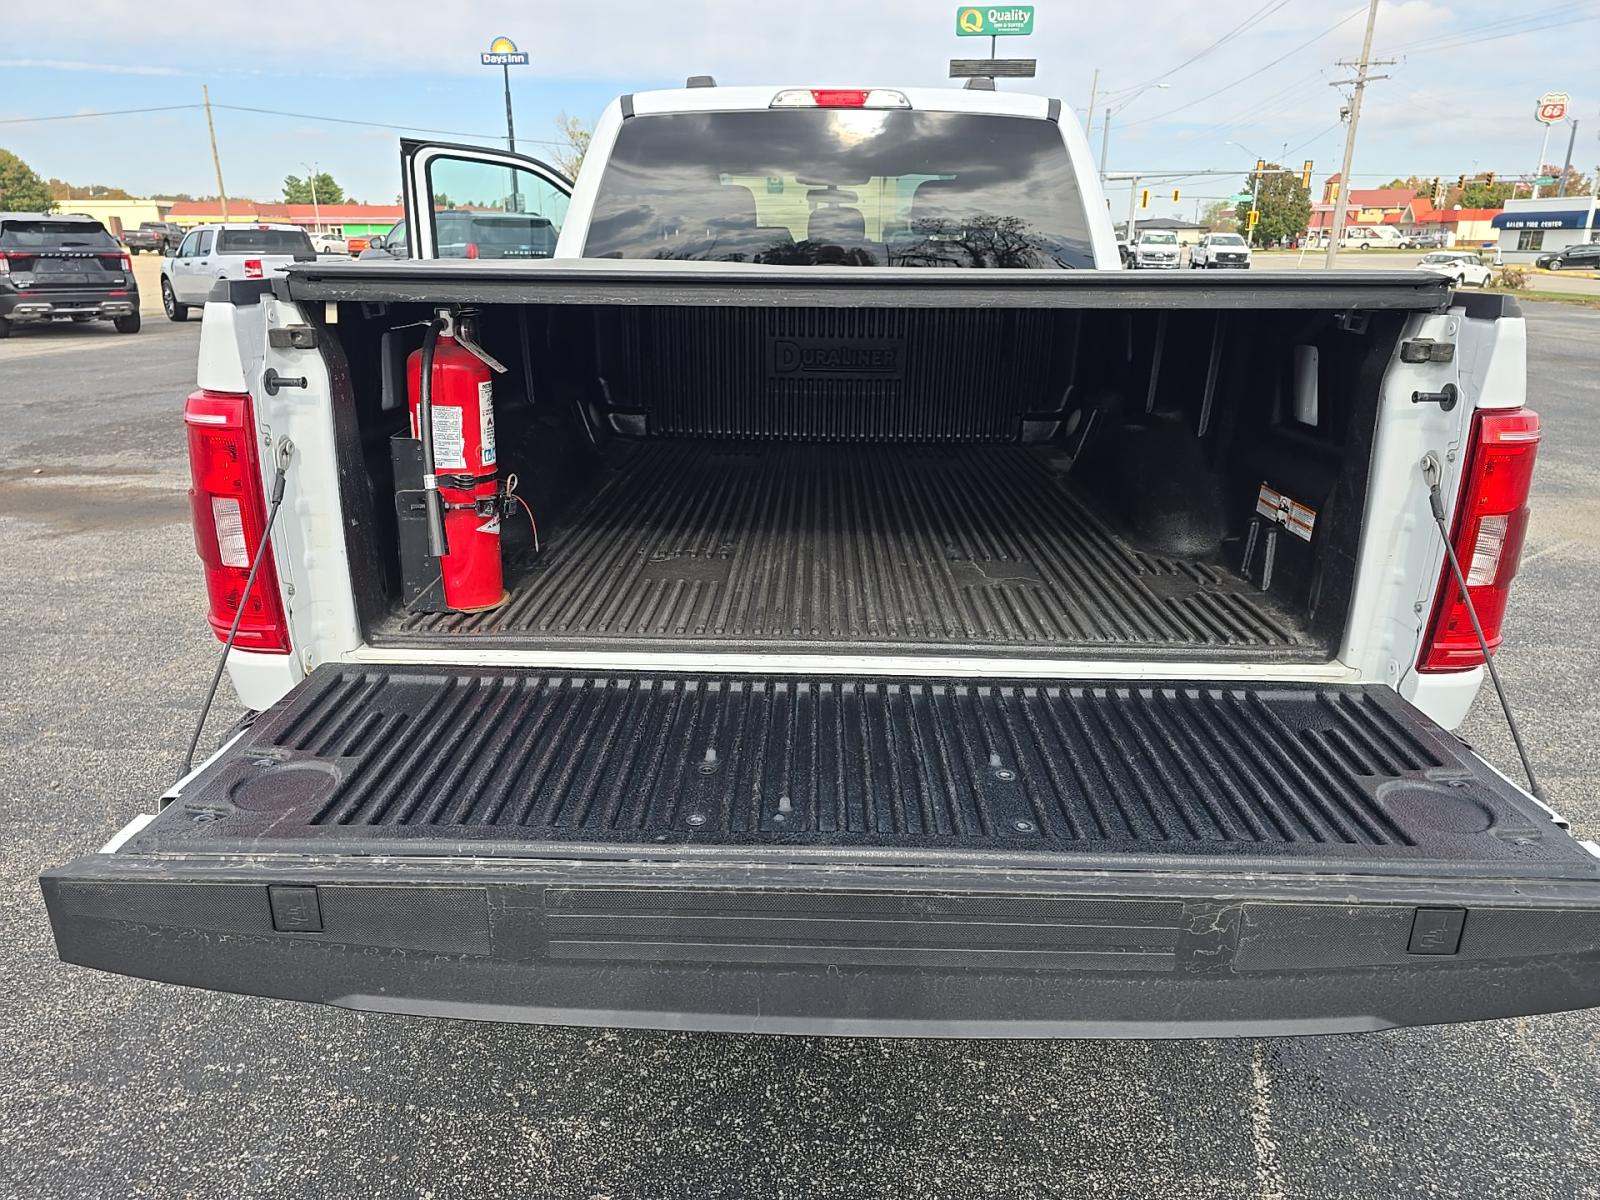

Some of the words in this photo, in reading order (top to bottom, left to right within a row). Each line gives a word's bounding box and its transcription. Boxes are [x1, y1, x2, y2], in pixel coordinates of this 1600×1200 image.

[960, 9, 983, 32] Q
[988, 9, 1030, 24] Quality
[1543, 105, 1563, 116] 66
[1541, 220, 1563, 228] CENTER
